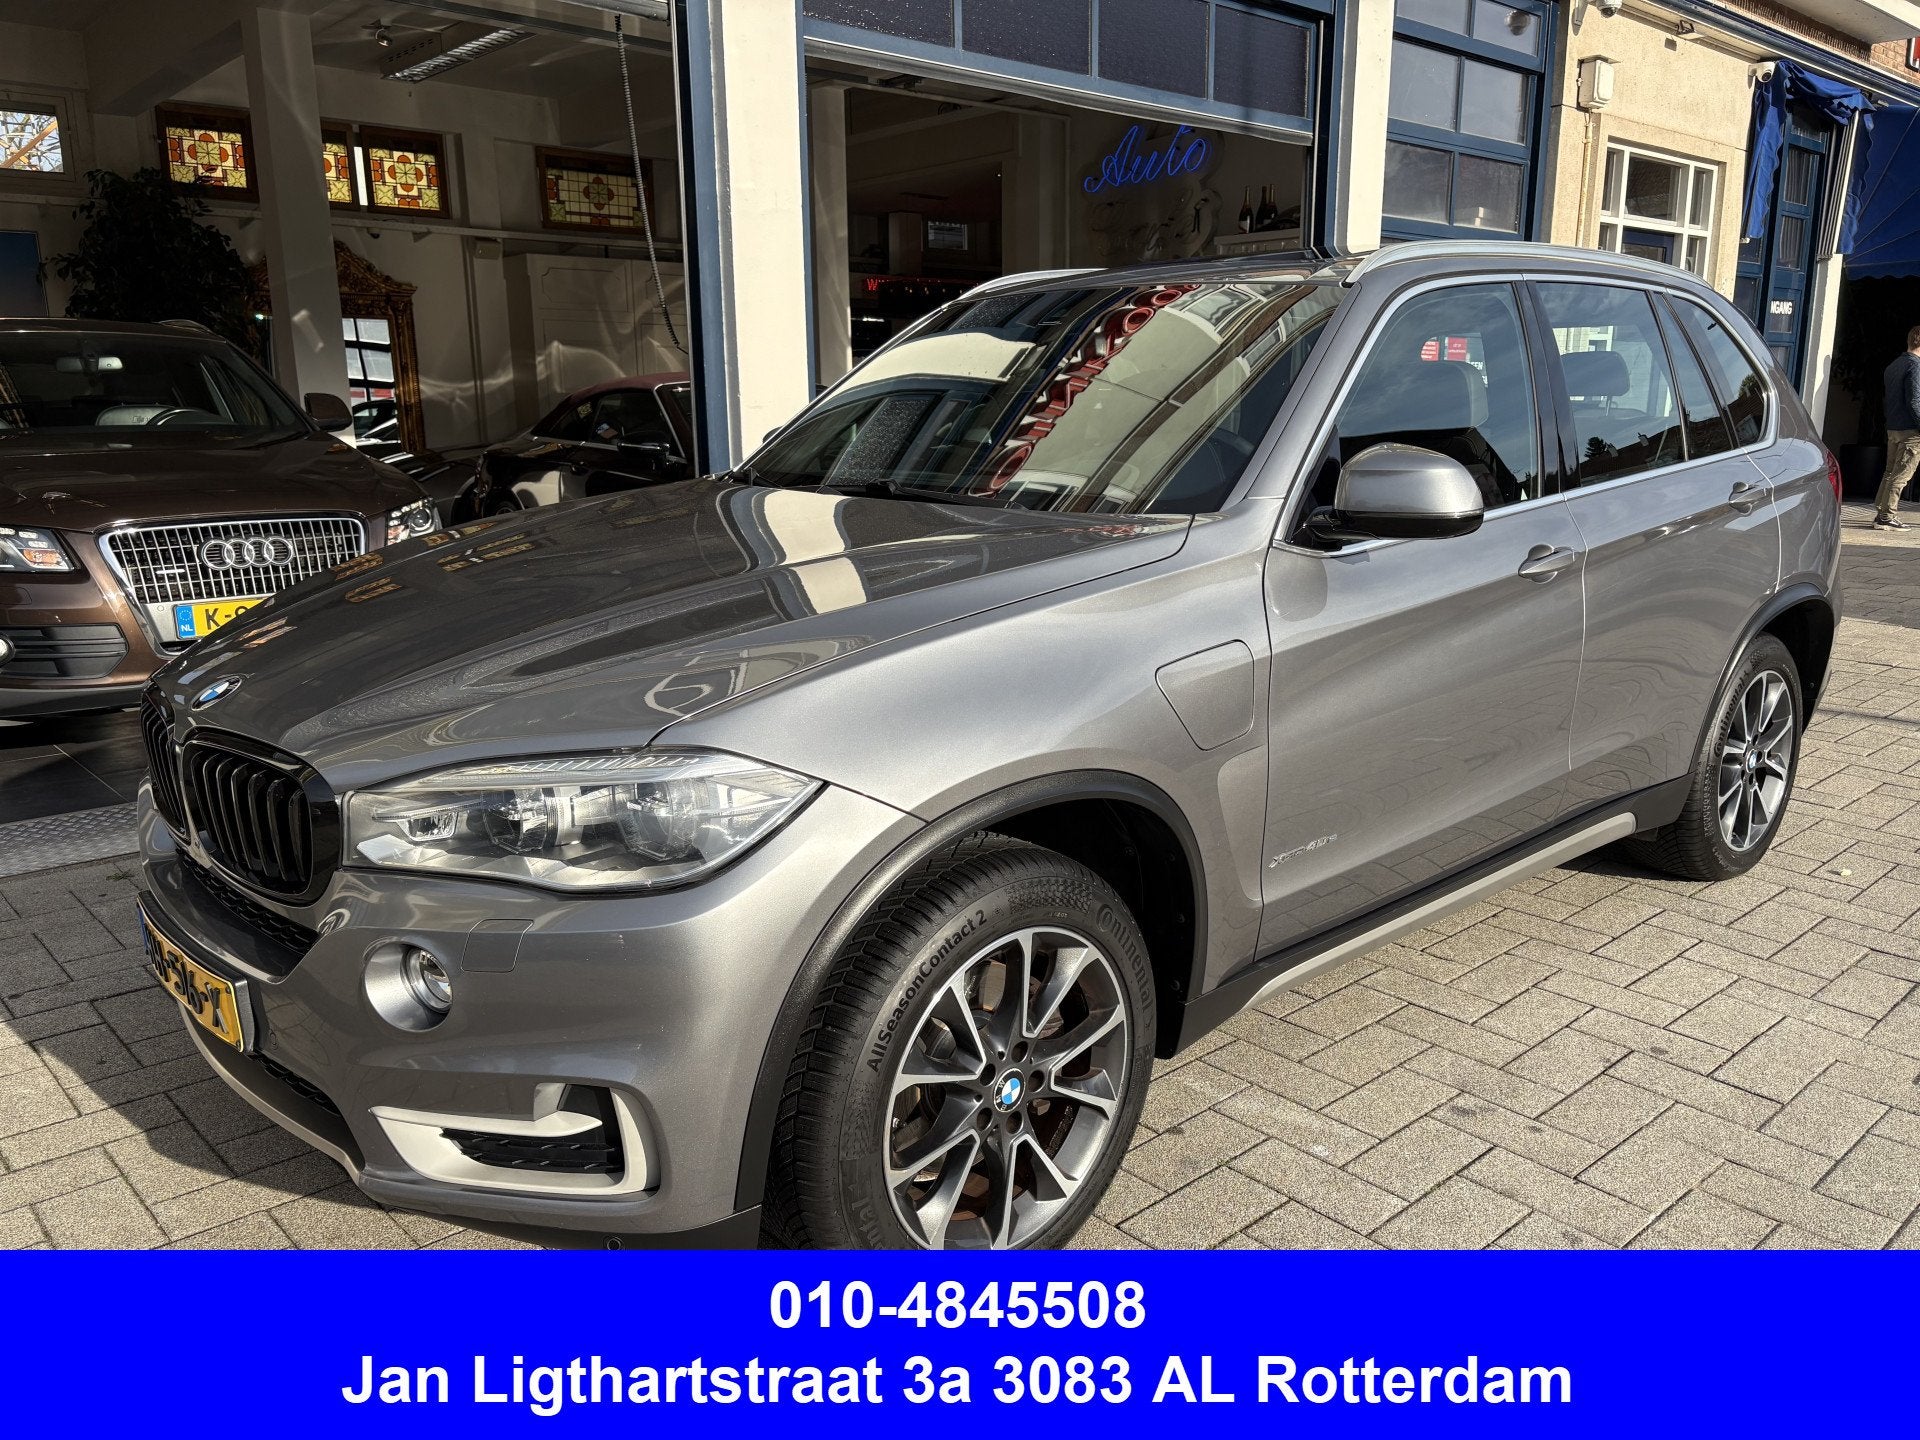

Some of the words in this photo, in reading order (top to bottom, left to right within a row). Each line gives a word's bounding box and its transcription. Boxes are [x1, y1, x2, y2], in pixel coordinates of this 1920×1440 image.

[1084, 124, 1206, 193] Auto
[180, 624, 194, 632] NL
[866, 916, 978, 1073] AllSeasonContact
[975, 908, 988, 927] 2
[1096, 903, 1154, 1013] Continental
